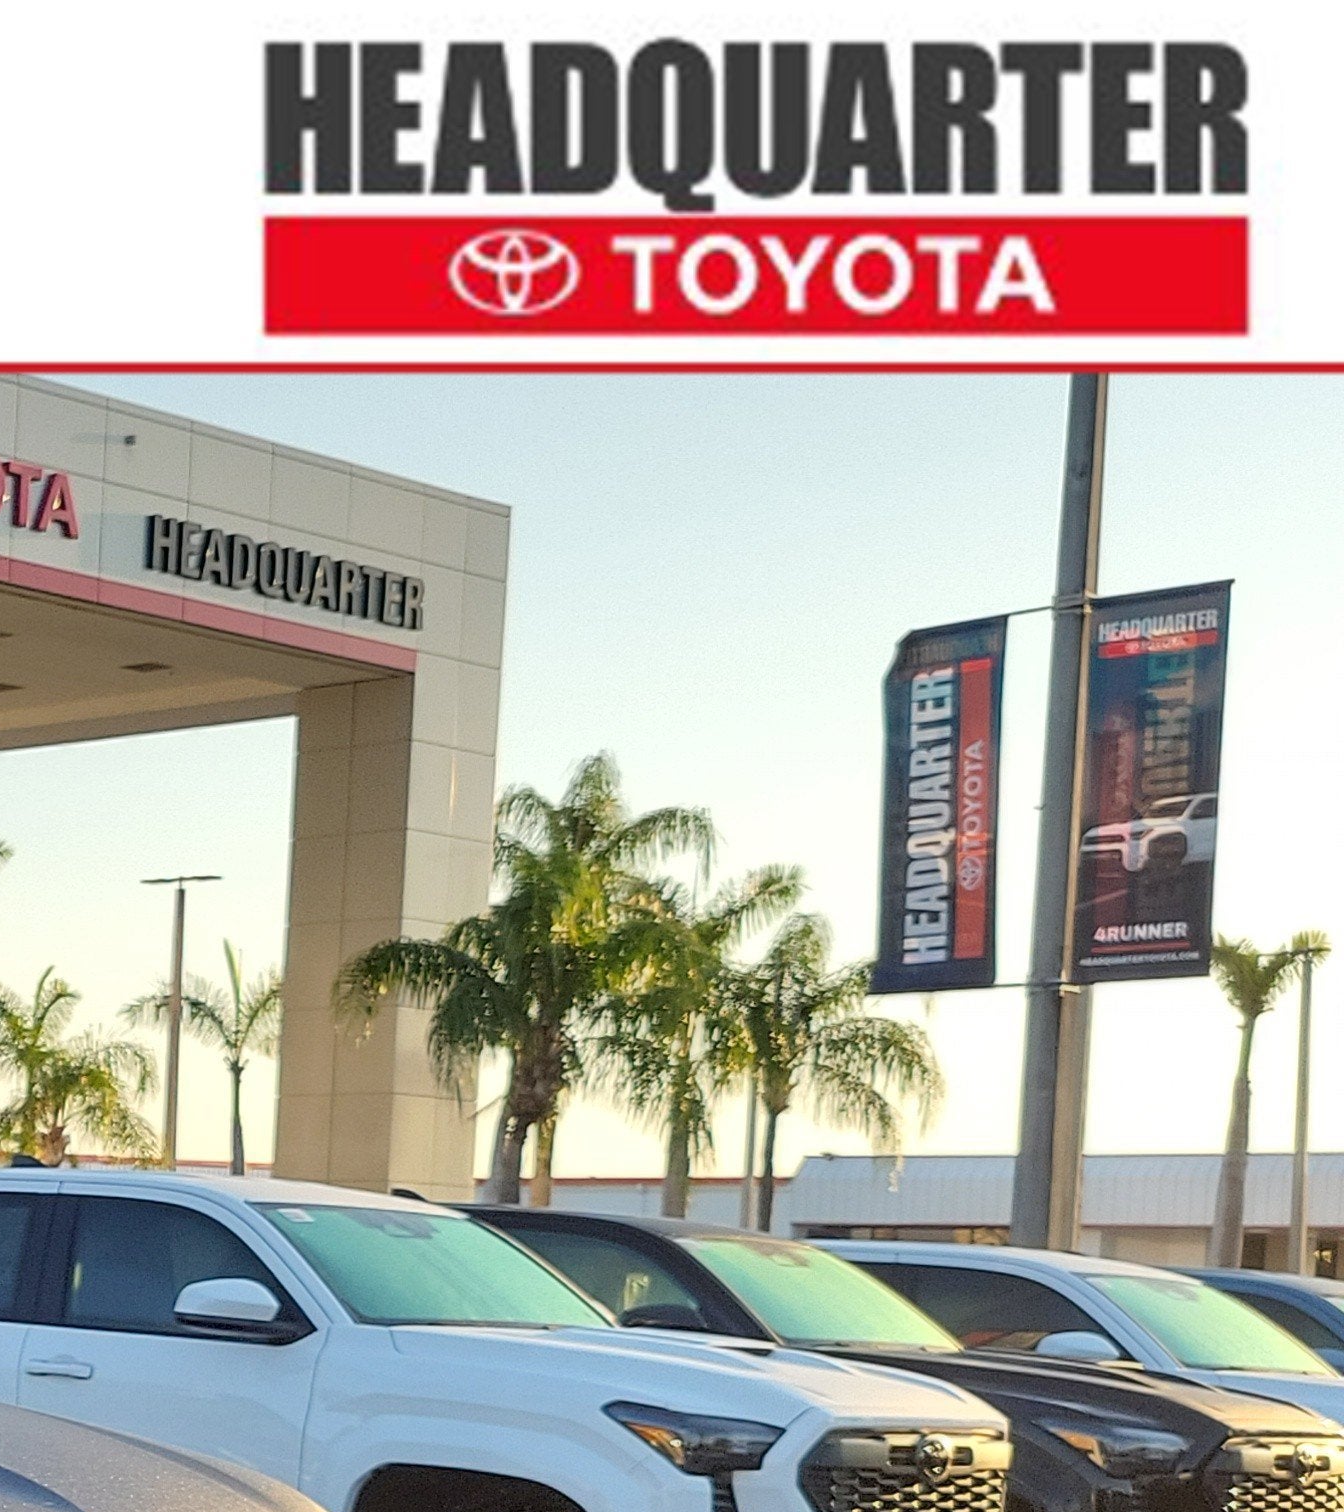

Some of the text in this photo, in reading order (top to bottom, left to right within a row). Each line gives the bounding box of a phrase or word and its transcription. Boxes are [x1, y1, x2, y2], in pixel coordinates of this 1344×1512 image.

[144, 514, 425, 631] HEADQUARTER
[1098, 608, 1219, 644] HEADQUARTER
[902, 667, 956, 965] HEADQUARTER
[962, 739, 985, 852] TOYOTA
[1093, 921, 1189, 943] 4RUNNER
